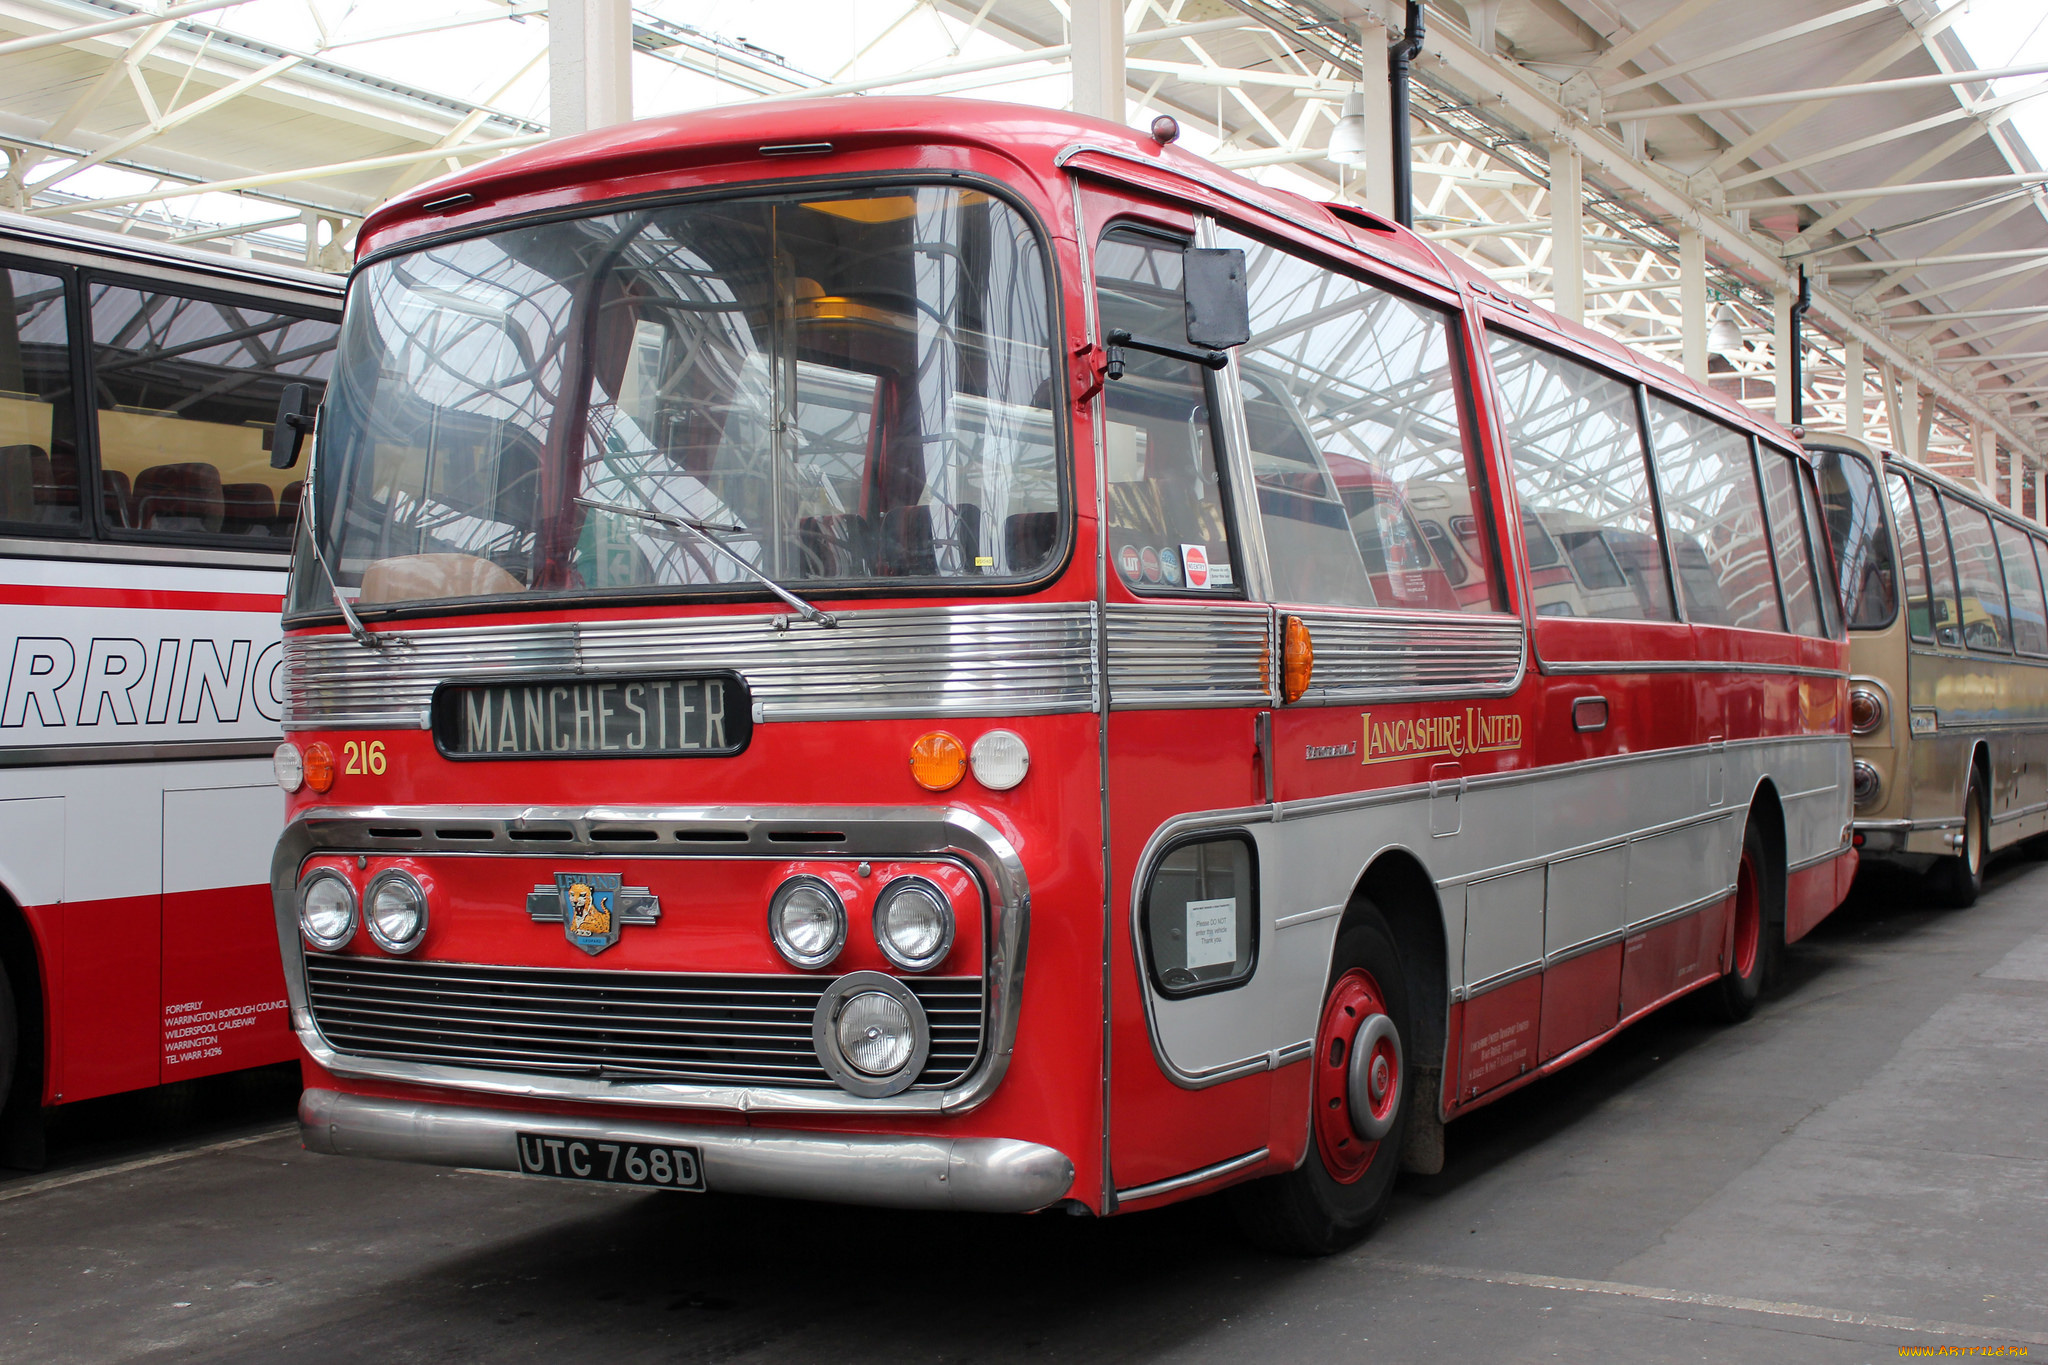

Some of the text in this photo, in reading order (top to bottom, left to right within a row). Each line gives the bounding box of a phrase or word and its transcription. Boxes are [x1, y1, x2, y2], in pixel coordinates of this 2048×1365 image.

[466, 680, 726, 753] MANCHESTER
[1361, 707, 1523, 765] LANCASHIRE UNITED
[343, 740, 387, 776] 216
[558, 874, 619, 889] LEYLAND
[165, 1000, 289, 1027] WARRINGTON BOROUGH COUNCIL
[166, 1001, 203, 1015] FORMERLY
[165, 1017, 257, 1039] WILDERSPOOL CAUSEWAY
[165, 1035, 218, 1052] WARRINGTON
[203, 1047, 223, 1059] 34296
[520, 1136, 698, 1186] UTC 768D
